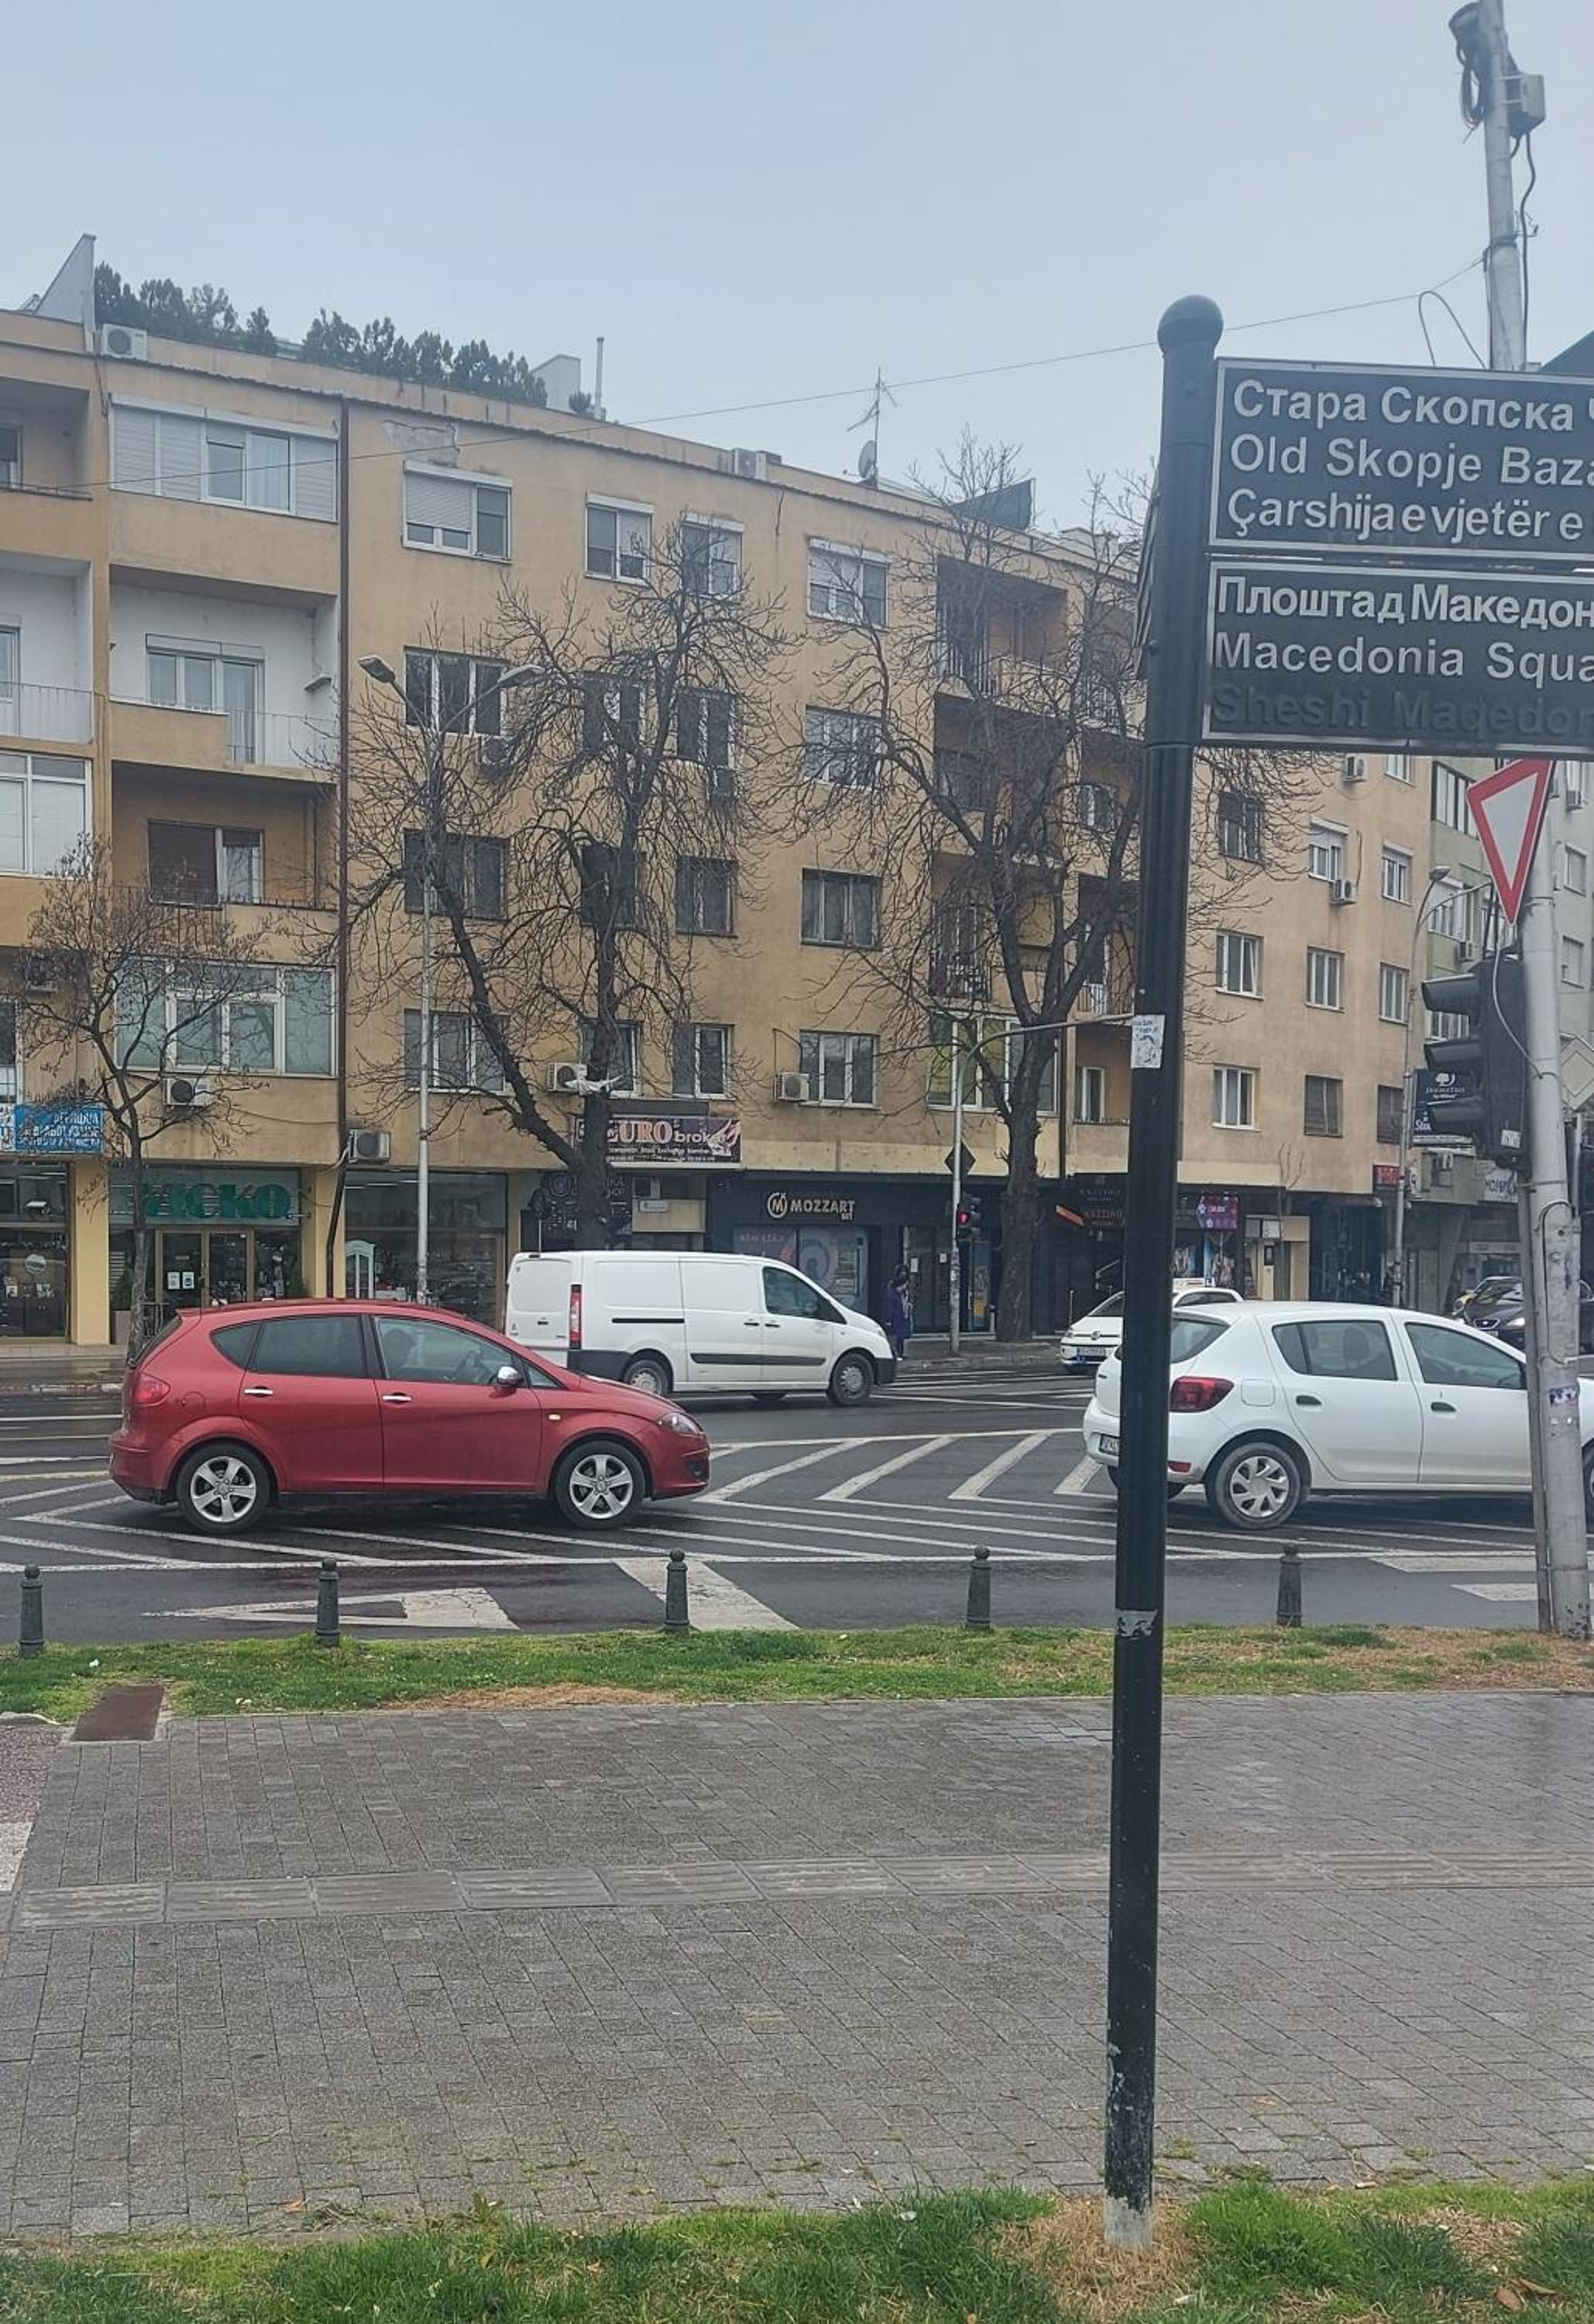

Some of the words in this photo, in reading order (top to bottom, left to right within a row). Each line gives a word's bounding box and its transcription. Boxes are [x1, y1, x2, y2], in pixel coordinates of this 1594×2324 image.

[1233, 378, 1366, 429] Стара
[1381, 387, 1574, 431] Скопска
[1231, 433, 1308, 474] Old
[1326, 437, 1481, 490] Skopje
[1228, 487, 1394, 539] Çarshija
[1401, 505, 1427, 534] e
[1430, 497, 1551, 543] vjetër
[1558, 511, 1584, 541] e
[1218, 576, 1404, 624] Плоштад
[1214, 631, 1464, 676] Macedonia
[1212, 684, 1369, 730] Sheshi
[790, 1199, 855, 1212] MOZZART
